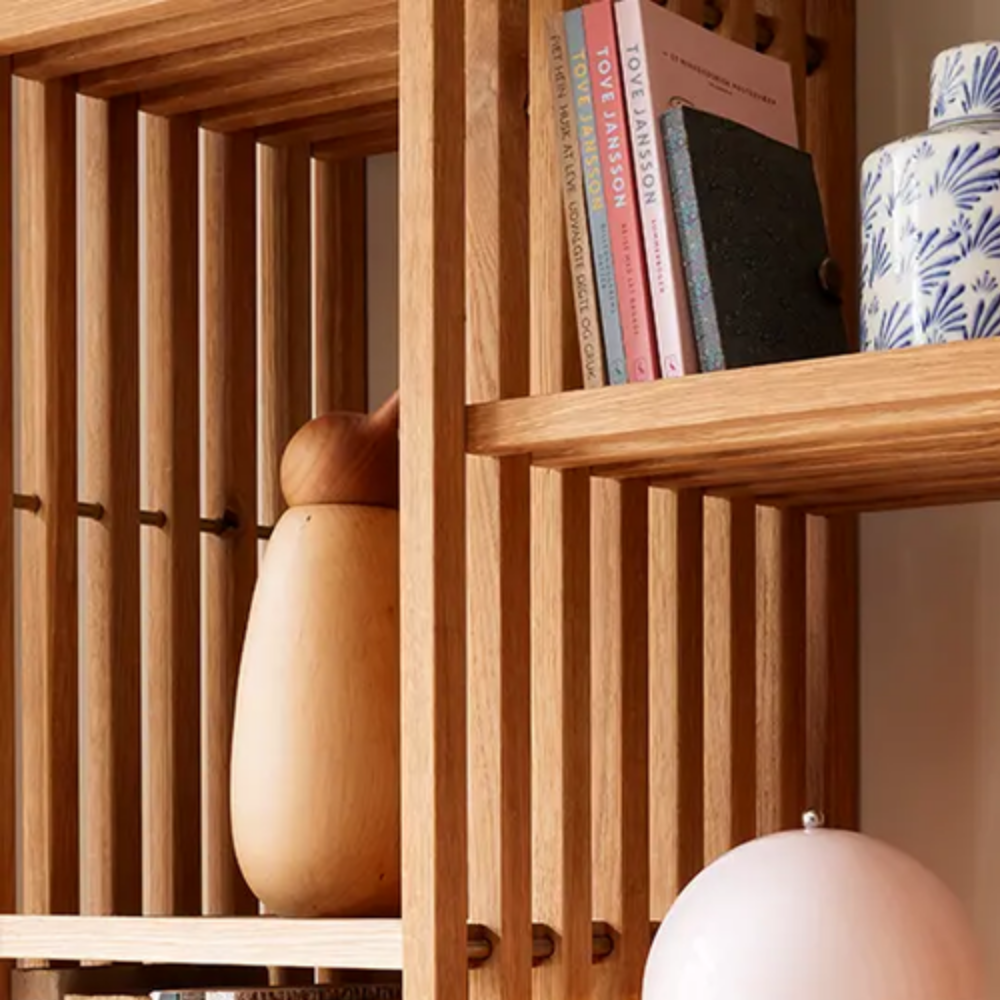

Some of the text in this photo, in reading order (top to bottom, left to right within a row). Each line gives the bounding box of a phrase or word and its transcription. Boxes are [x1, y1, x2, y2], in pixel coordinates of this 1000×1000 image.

[571, 47, 604, 211] TOVE JANSSON
[595, 45, 627, 208] TOVE JANSSON
[626, 44, 658, 204] TOVE JANSSON
[580, 318, 592, 340] OG
